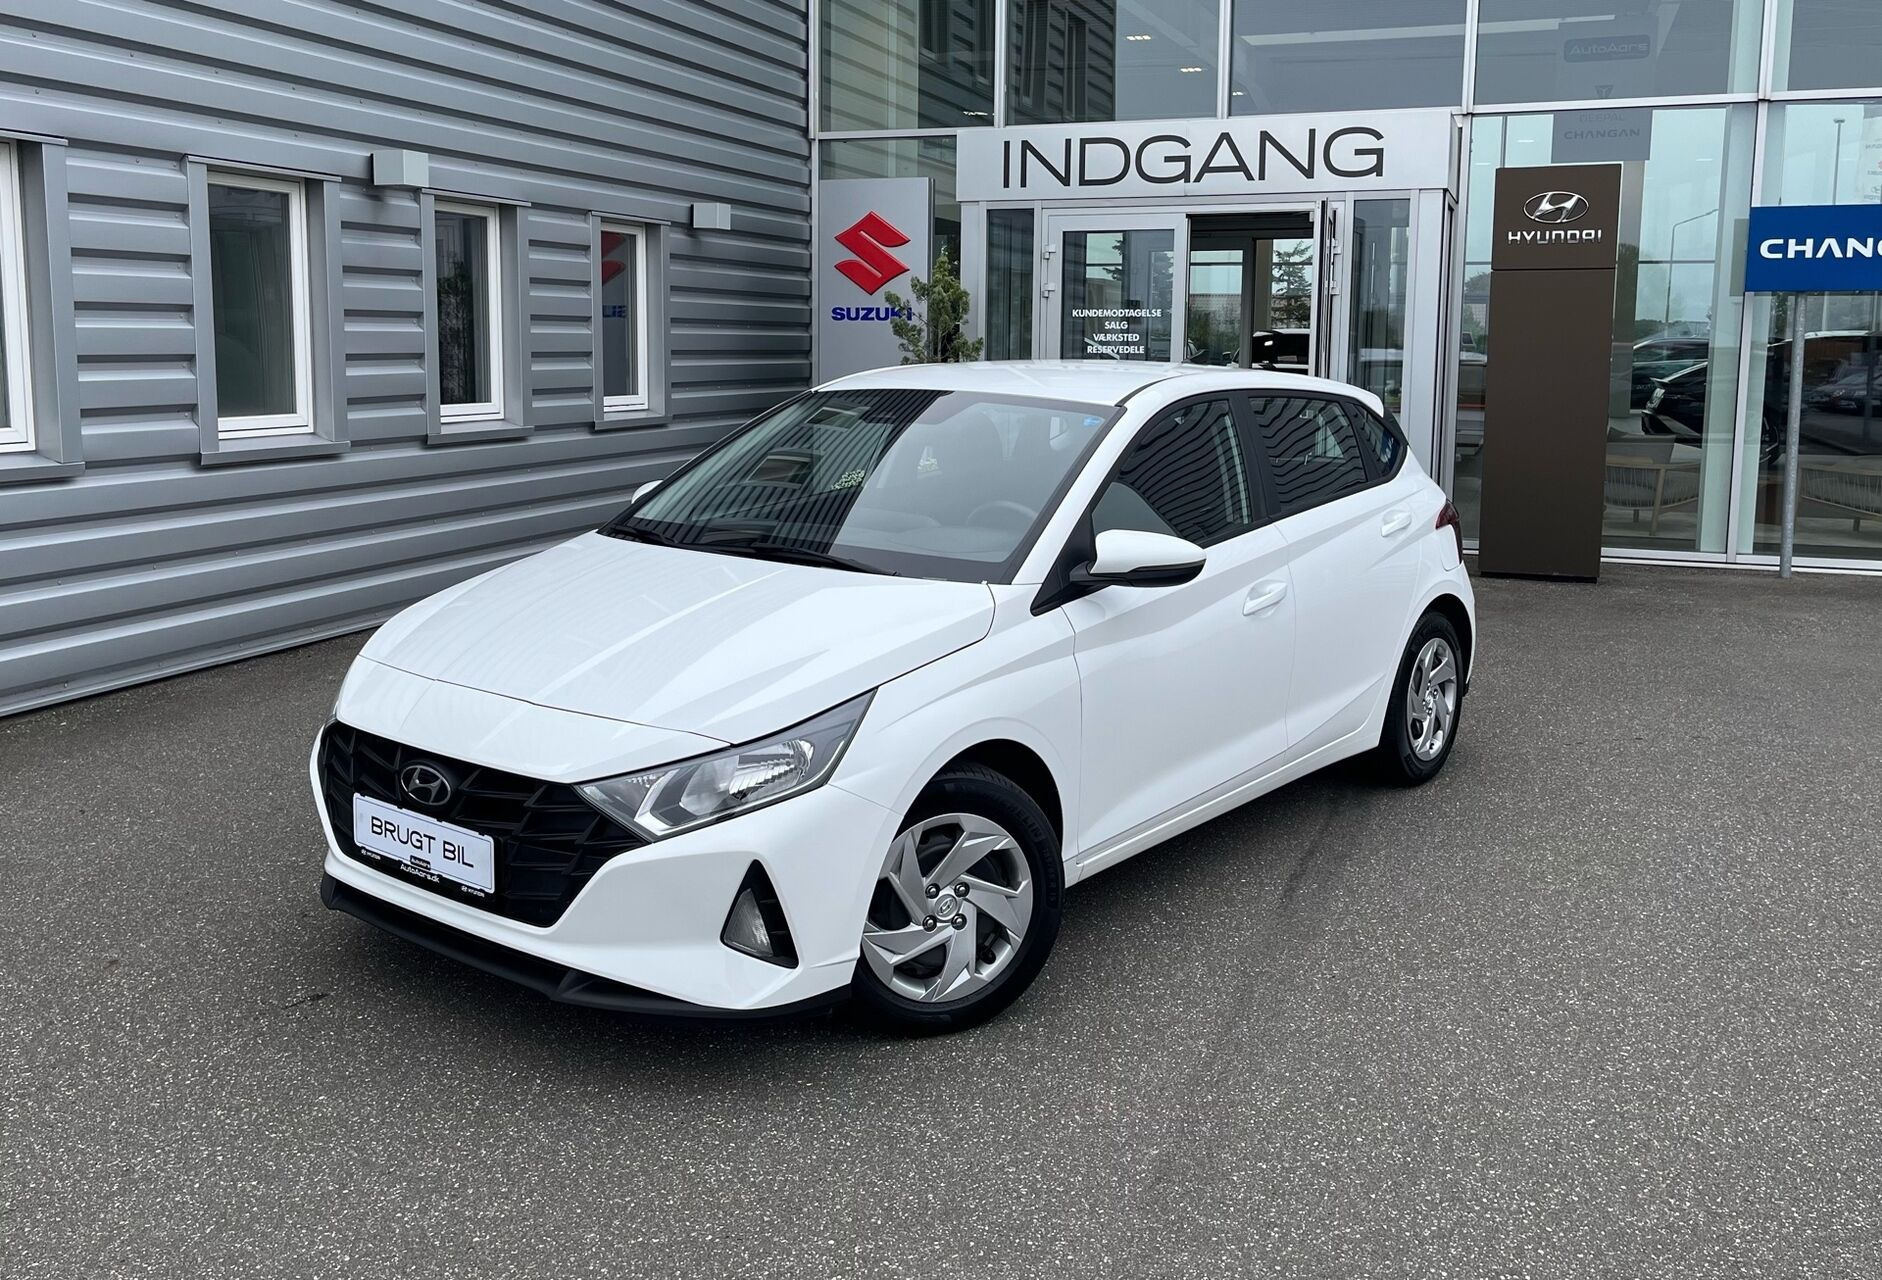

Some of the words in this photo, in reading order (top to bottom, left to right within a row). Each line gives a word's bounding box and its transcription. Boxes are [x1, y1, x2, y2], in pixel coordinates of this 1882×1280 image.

[1563, 128, 1640, 140] CHANGAN
[1002, 126, 1385, 189] INDGANG
[1507, 229, 1602, 244] HYUNDAI
[1759, 237, 1882, 259] CHAN
[1072, 309, 1162, 318] KUNDEMODTAGELSE
[1104, 321, 1129, 330] SALG
[1093, 333, 1140, 342] VÆRKSTED
[1087, 345, 1145, 354] RESERVEDELE
[371, 816, 436, 854] BRUGT
[443, 839, 474, 868] BIL
